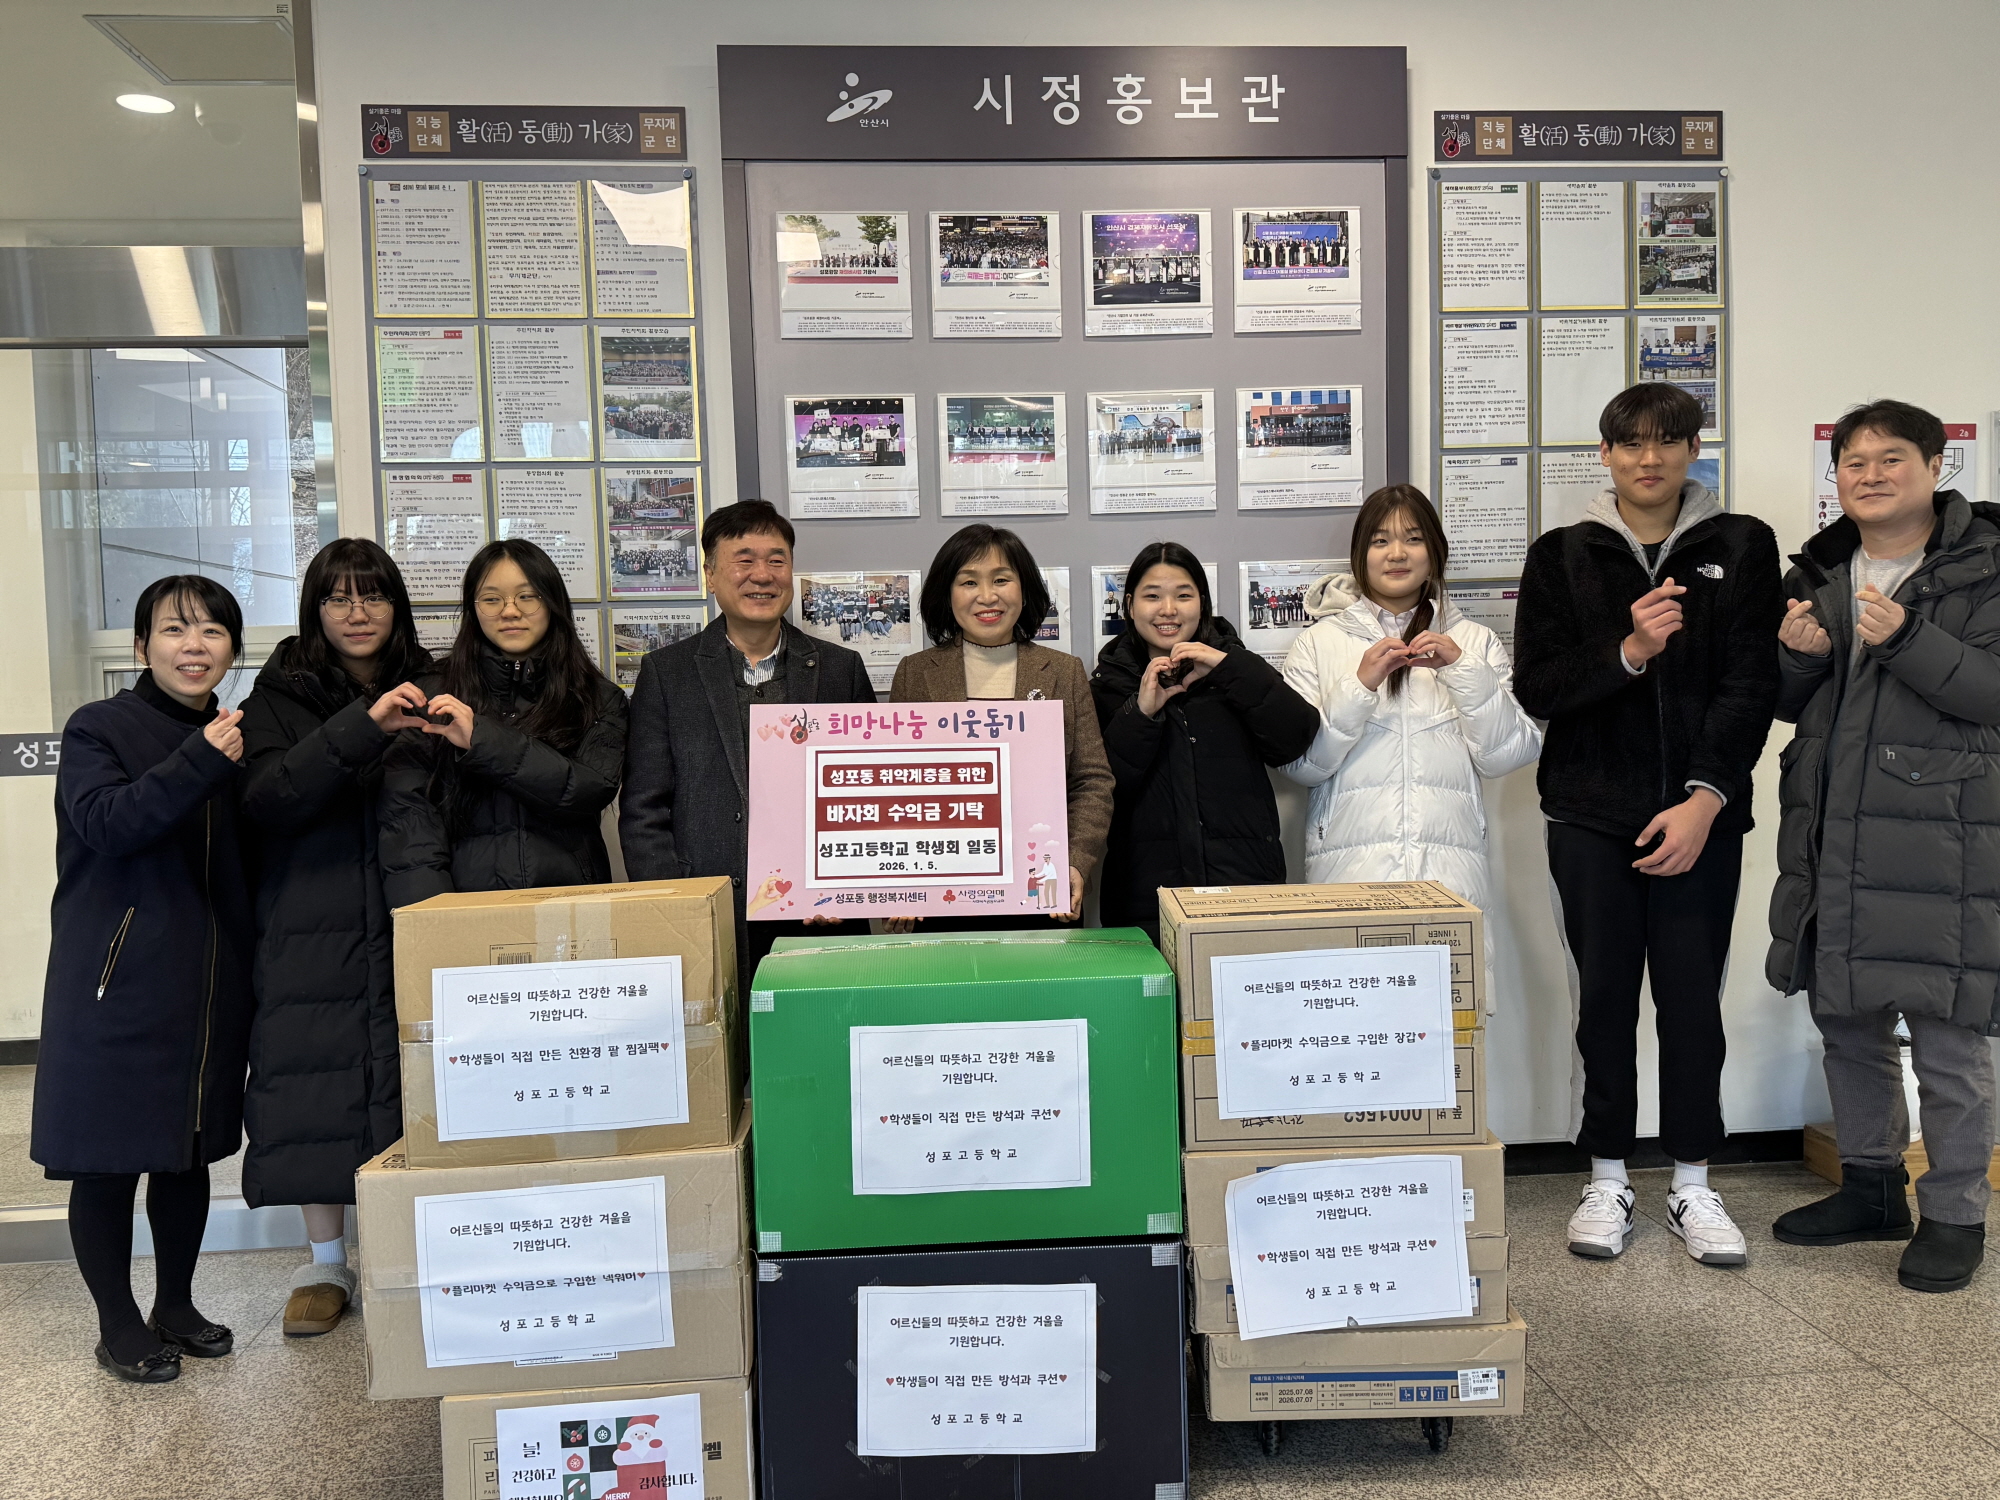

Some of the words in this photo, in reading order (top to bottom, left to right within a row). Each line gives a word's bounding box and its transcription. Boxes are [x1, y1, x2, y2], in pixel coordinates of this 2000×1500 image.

[456, 118, 513, 143] 활(活)
[518, 118, 574, 144] 동(動)
[578, 119, 634, 144] 가(家)
[643, 117, 676, 131] 무지개
[859, 118, 890, 128] 안산시
[1684, 121, 1714, 133] 무지개
[1518, 122, 1569, 147] 활(活)
[1573, 122, 1622, 147] 동(動)
[1626, 122, 1676, 147] 가(家)
[827, 710, 928, 740] 희망나눔
[937, 708, 1026, 739] 이웃돕기
[830, 769, 874, 785] 성포동
[879, 767, 952, 784] 취약계층을
[957, 766, 986, 782] 위한
[826, 804, 880, 823] 바자회
[887, 803, 941, 823] 수익금
[948, 802, 984, 821] 기탁
[819, 841, 909, 858] 성포고등학교
[916, 839, 960, 855] 학생회
[966, 838, 997, 854] 일동
[879, 861, 909, 871] 2026.
[913, 861, 923, 871] 1.
[927, 861, 938, 870] 5.
[835, 893, 865, 904] 성포동
[868, 891, 927, 903] 행정복지센터
[1244, 980, 1295, 994] 어르신들의
[1300, 978, 1343, 991] 따뜻하고
[1348, 976, 1380, 989] 건강한
[1386, 974, 1417, 987] 겨울을
[467, 990, 521, 1005] 어르신들의
[527, 988, 572, 1002] 따뜻하고
[577, 986, 610, 1000] 건강한
[616, 984, 649, 998] 겨울을
[1303, 996, 1359, 1010] 기원합니다.
[529, 1009, 588, 1023] 기원합니다.
[1250, 1037, 1293, 1051] 플리마켓
[1298, 1035, 1351, 1048] 수익금으로
[1356, 1032, 1389, 1046] 구입한
[1393, 1031, 1417, 1044] 장갑
[459, 1052, 505, 1067] 학생들이
[511, 1051, 533, 1065] 직접
[539, 1049, 562, 1063] 만든
[568, 1046, 602, 1061] 친환경
[608, 1044, 620, 1058] 팥
[626, 1041, 660, 1057] 찜질팩
[882, 1054, 935, 1067] 어르신들의
[939, 1053, 982, 1066] 따뜻하고
[987, 1051, 1020, 1065] 건강한
[1024, 1050, 1056, 1063] 겨울을
[942, 1072, 998, 1085] 기원합니다.
[889, 1113, 933, 1126] 학생들이
[938, 1112, 960, 1124] 직접
[965, 1111, 987, 1123] 만든
[992, 1110, 1026, 1122] 방석과
[1030, 1108, 1052, 1121] 쿠션
[1256, 1191, 1307, 1207] 어르신들의
[1313, 1189, 1355, 1203] 따뜻하고
[1360, 1185, 1392, 1200] 건강한
[1397, 1182, 1429, 1196] 겨울을
[1316, 1206, 1372, 1221] 기원합니다.
[450, 1221, 505, 1238] 어르신들의
[510, 1218, 554, 1234] 따뜻하고
[559, 1215, 593, 1231] 건강한
[599, 1210, 632, 1226] 겨울을
[512, 1237, 572, 1253] 기원합니다.
[1266, 1247, 1310, 1263] 학생들이
[1315, 1246, 1336, 1260] 직접
[1341, 1244, 1363, 1258] 만든
[1368, 1241, 1401, 1256] 방석과
[1406, 1239, 1428, 1253] 쿠션
[451, 1283, 497, 1297] 플리마켓
[502, 1279, 557, 1293] 수익금으로
[563, 1275, 597, 1289] 구입한
[890, 1316, 942, 1329] 어르신들의
[947, 1315, 990, 1328] 따뜻하고
[995, 1315, 1027, 1328] 건강한
[1032, 1314, 1064, 1327] 겨울을
[949, 1335, 1005, 1348] 기원합니다.
[896, 1375, 939, 1388] 학생들이
[944, 1375, 965, 1388] 직접
[971, 1374, 993, 1387] 만든
[998, 1373, 1032, 1387] 방석과
[1037, 1372, 1059, 1386] 쿠션
[521, 1442, 541, 1459] 늘!
[511, 1468, 557, 1484] 건강하고
[638, 1472, 698, 1490] 감사합니다.
